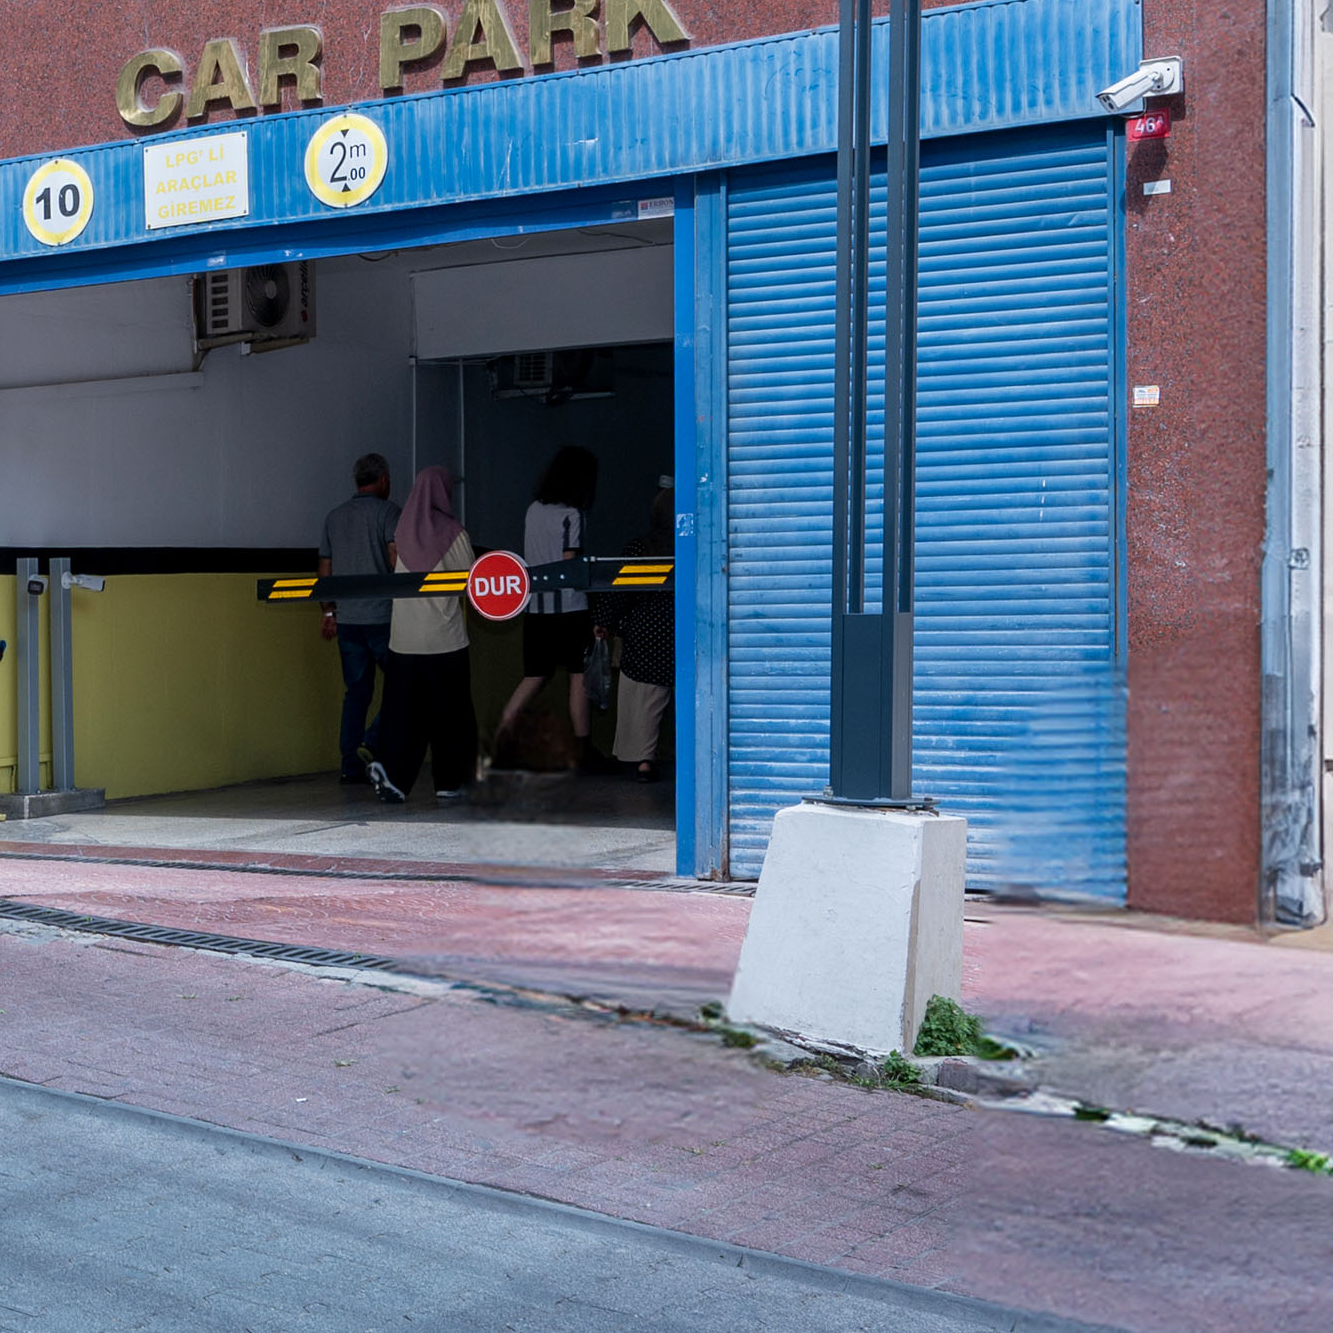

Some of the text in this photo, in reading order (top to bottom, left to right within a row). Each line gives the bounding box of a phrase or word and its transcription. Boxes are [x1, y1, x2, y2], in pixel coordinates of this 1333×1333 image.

[114, 24, 324, 127] CAR
[156, 170, 237, 195] ARAÇLAR
[35, 183, 80, 220] 10
[158, 195, 236, 219] GİREMEZ
[475, 575, 522, 597] DUR
